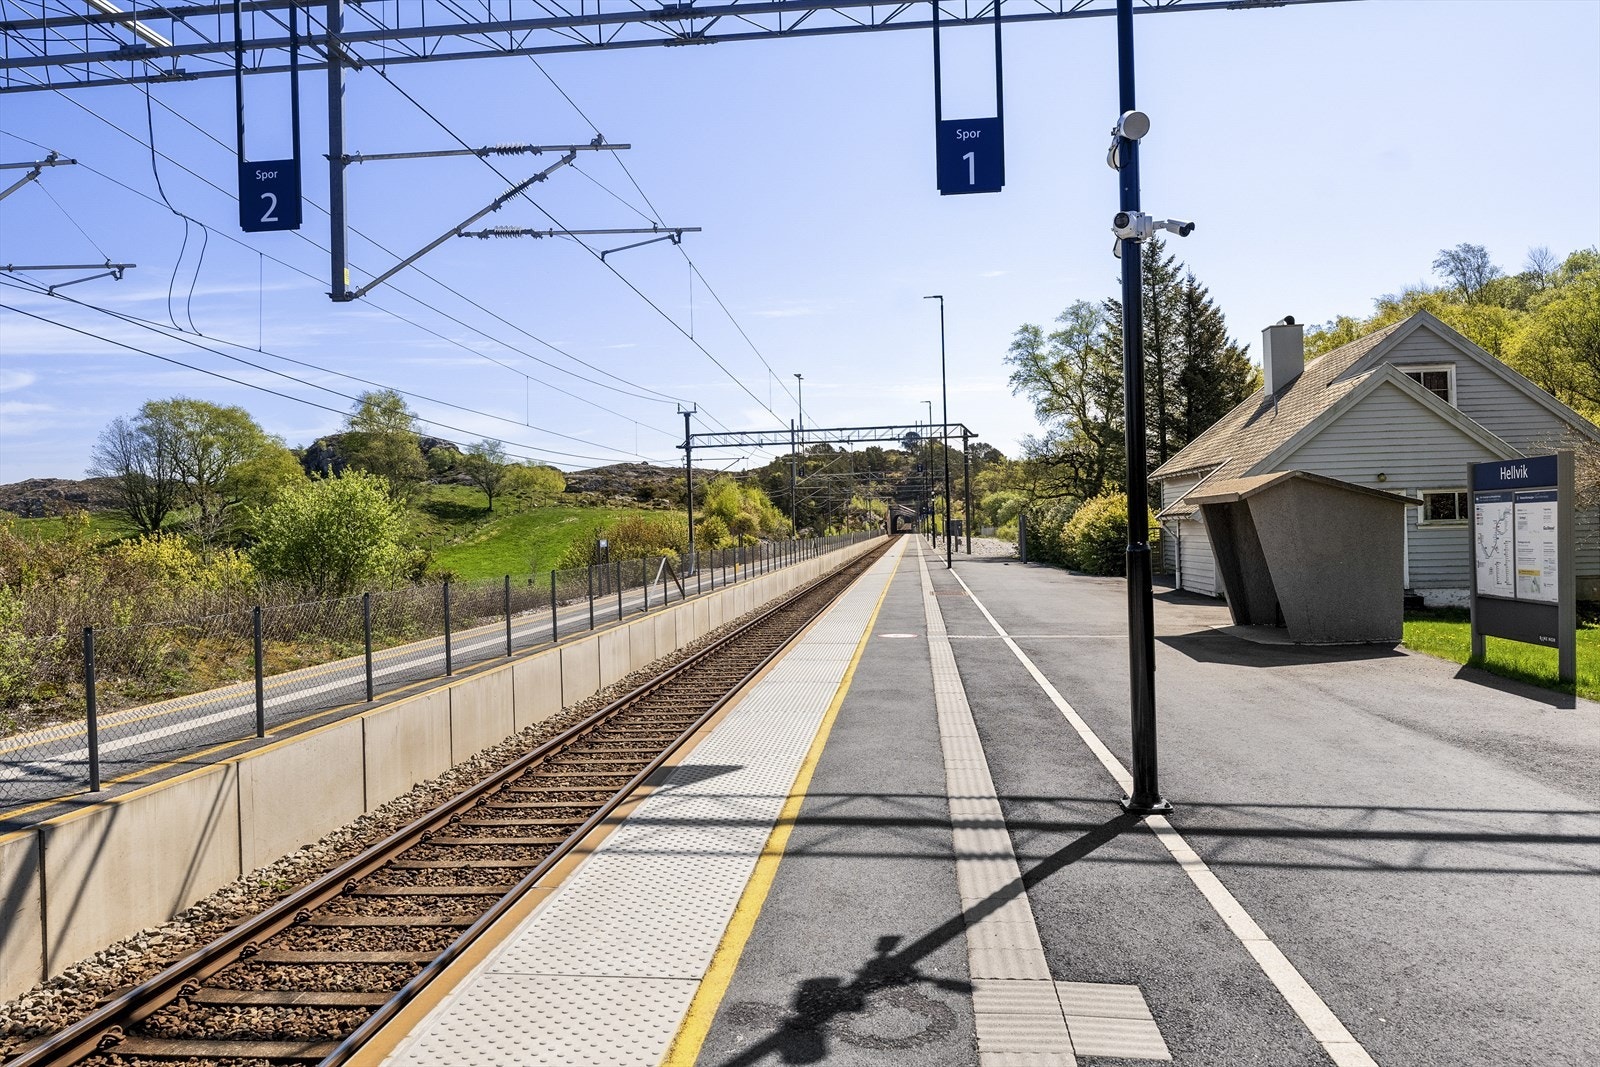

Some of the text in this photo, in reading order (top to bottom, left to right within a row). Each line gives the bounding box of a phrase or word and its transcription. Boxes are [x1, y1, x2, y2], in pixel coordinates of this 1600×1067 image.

[956, 129, 981, 141] Spor
[255, 169, 278, 181] Spor
[962, 151, 975, 185] 1
[260, 192, 279, 222] 2
[1500, 464, 1528, 480] Hellvik
